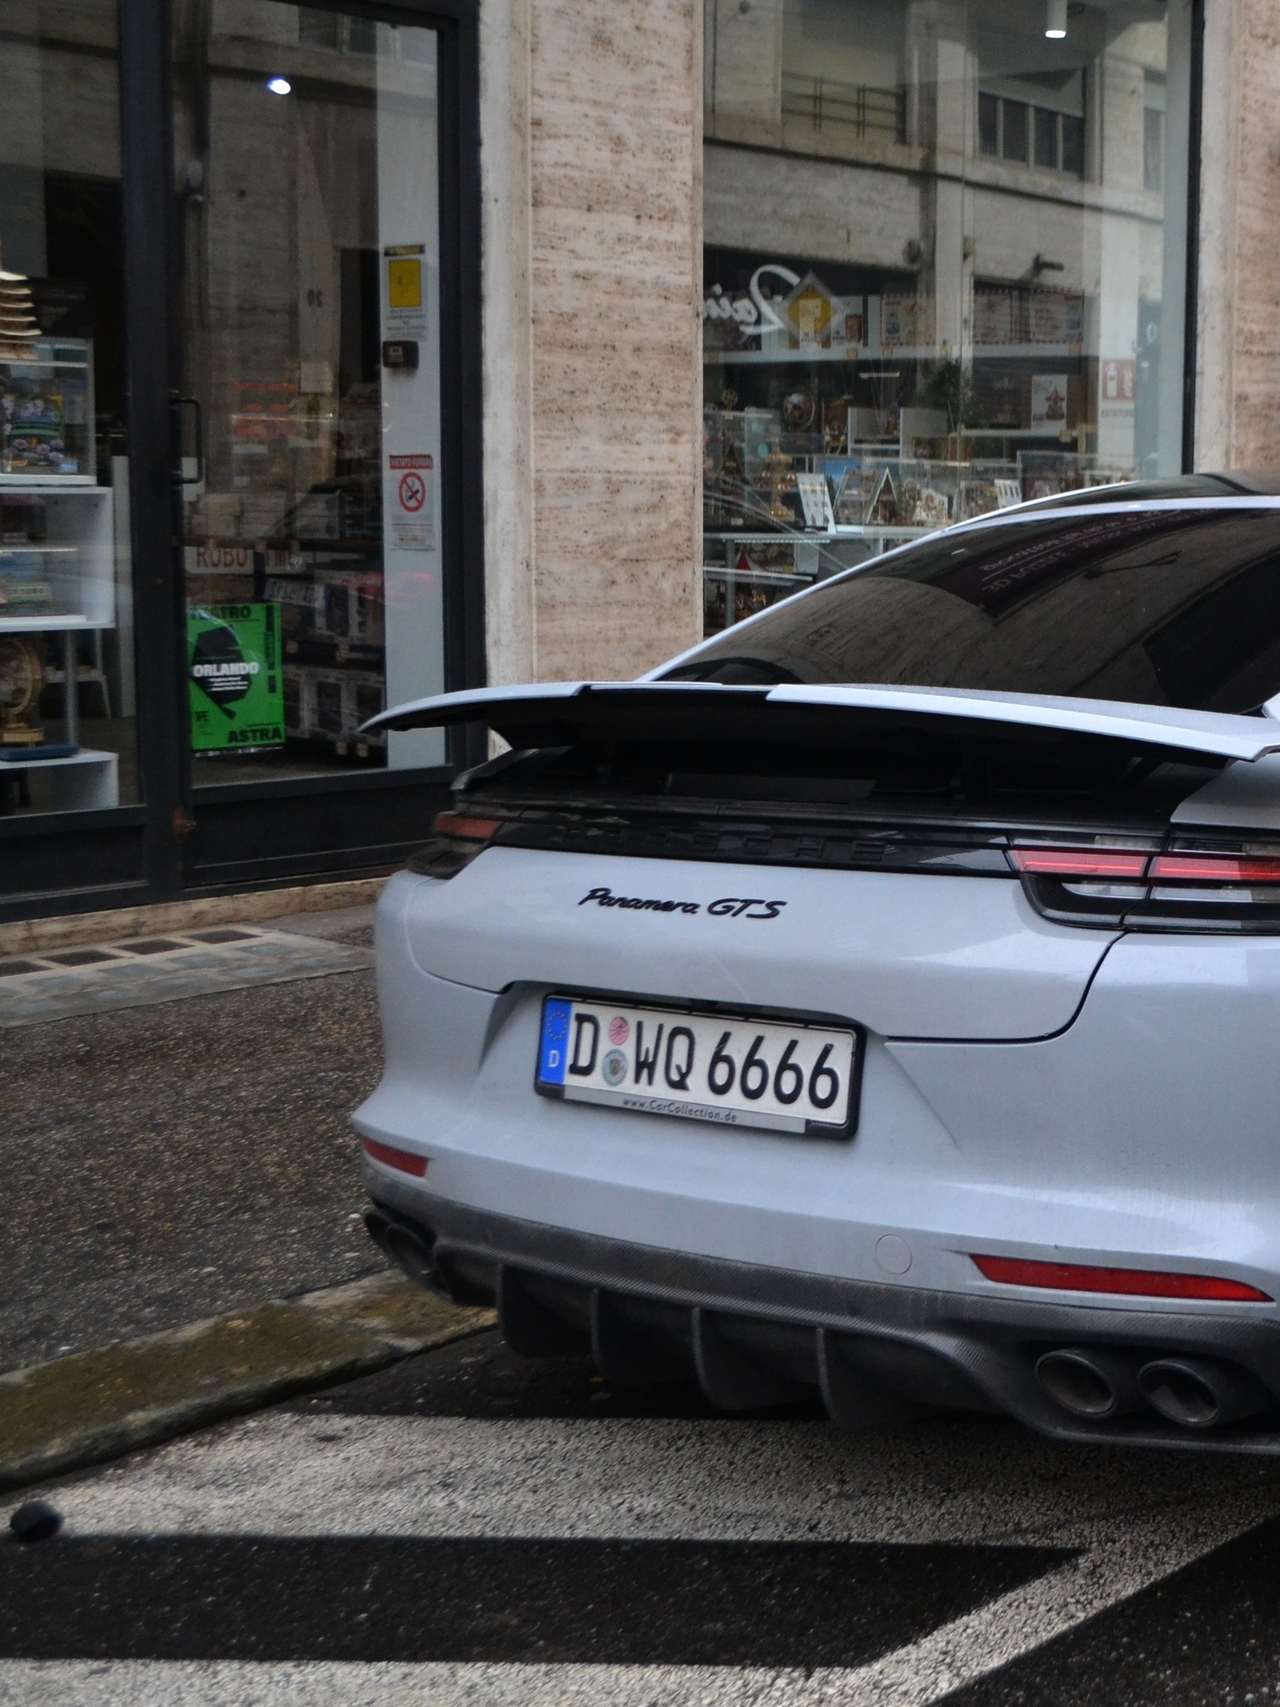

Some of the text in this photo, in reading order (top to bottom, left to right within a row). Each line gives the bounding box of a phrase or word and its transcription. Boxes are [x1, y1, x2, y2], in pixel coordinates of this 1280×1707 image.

[193, 662, 260, 677] ORLANDO
[228, 727, 283, 744] ASTRA
[578, 887, 788, 919] Panamera GTS
[548, 1049, 560, 1068] D
[568, 1012, 841, 1110] D WQ 6666
[623, 1099, 738, 1122] www.CarCollection.de
